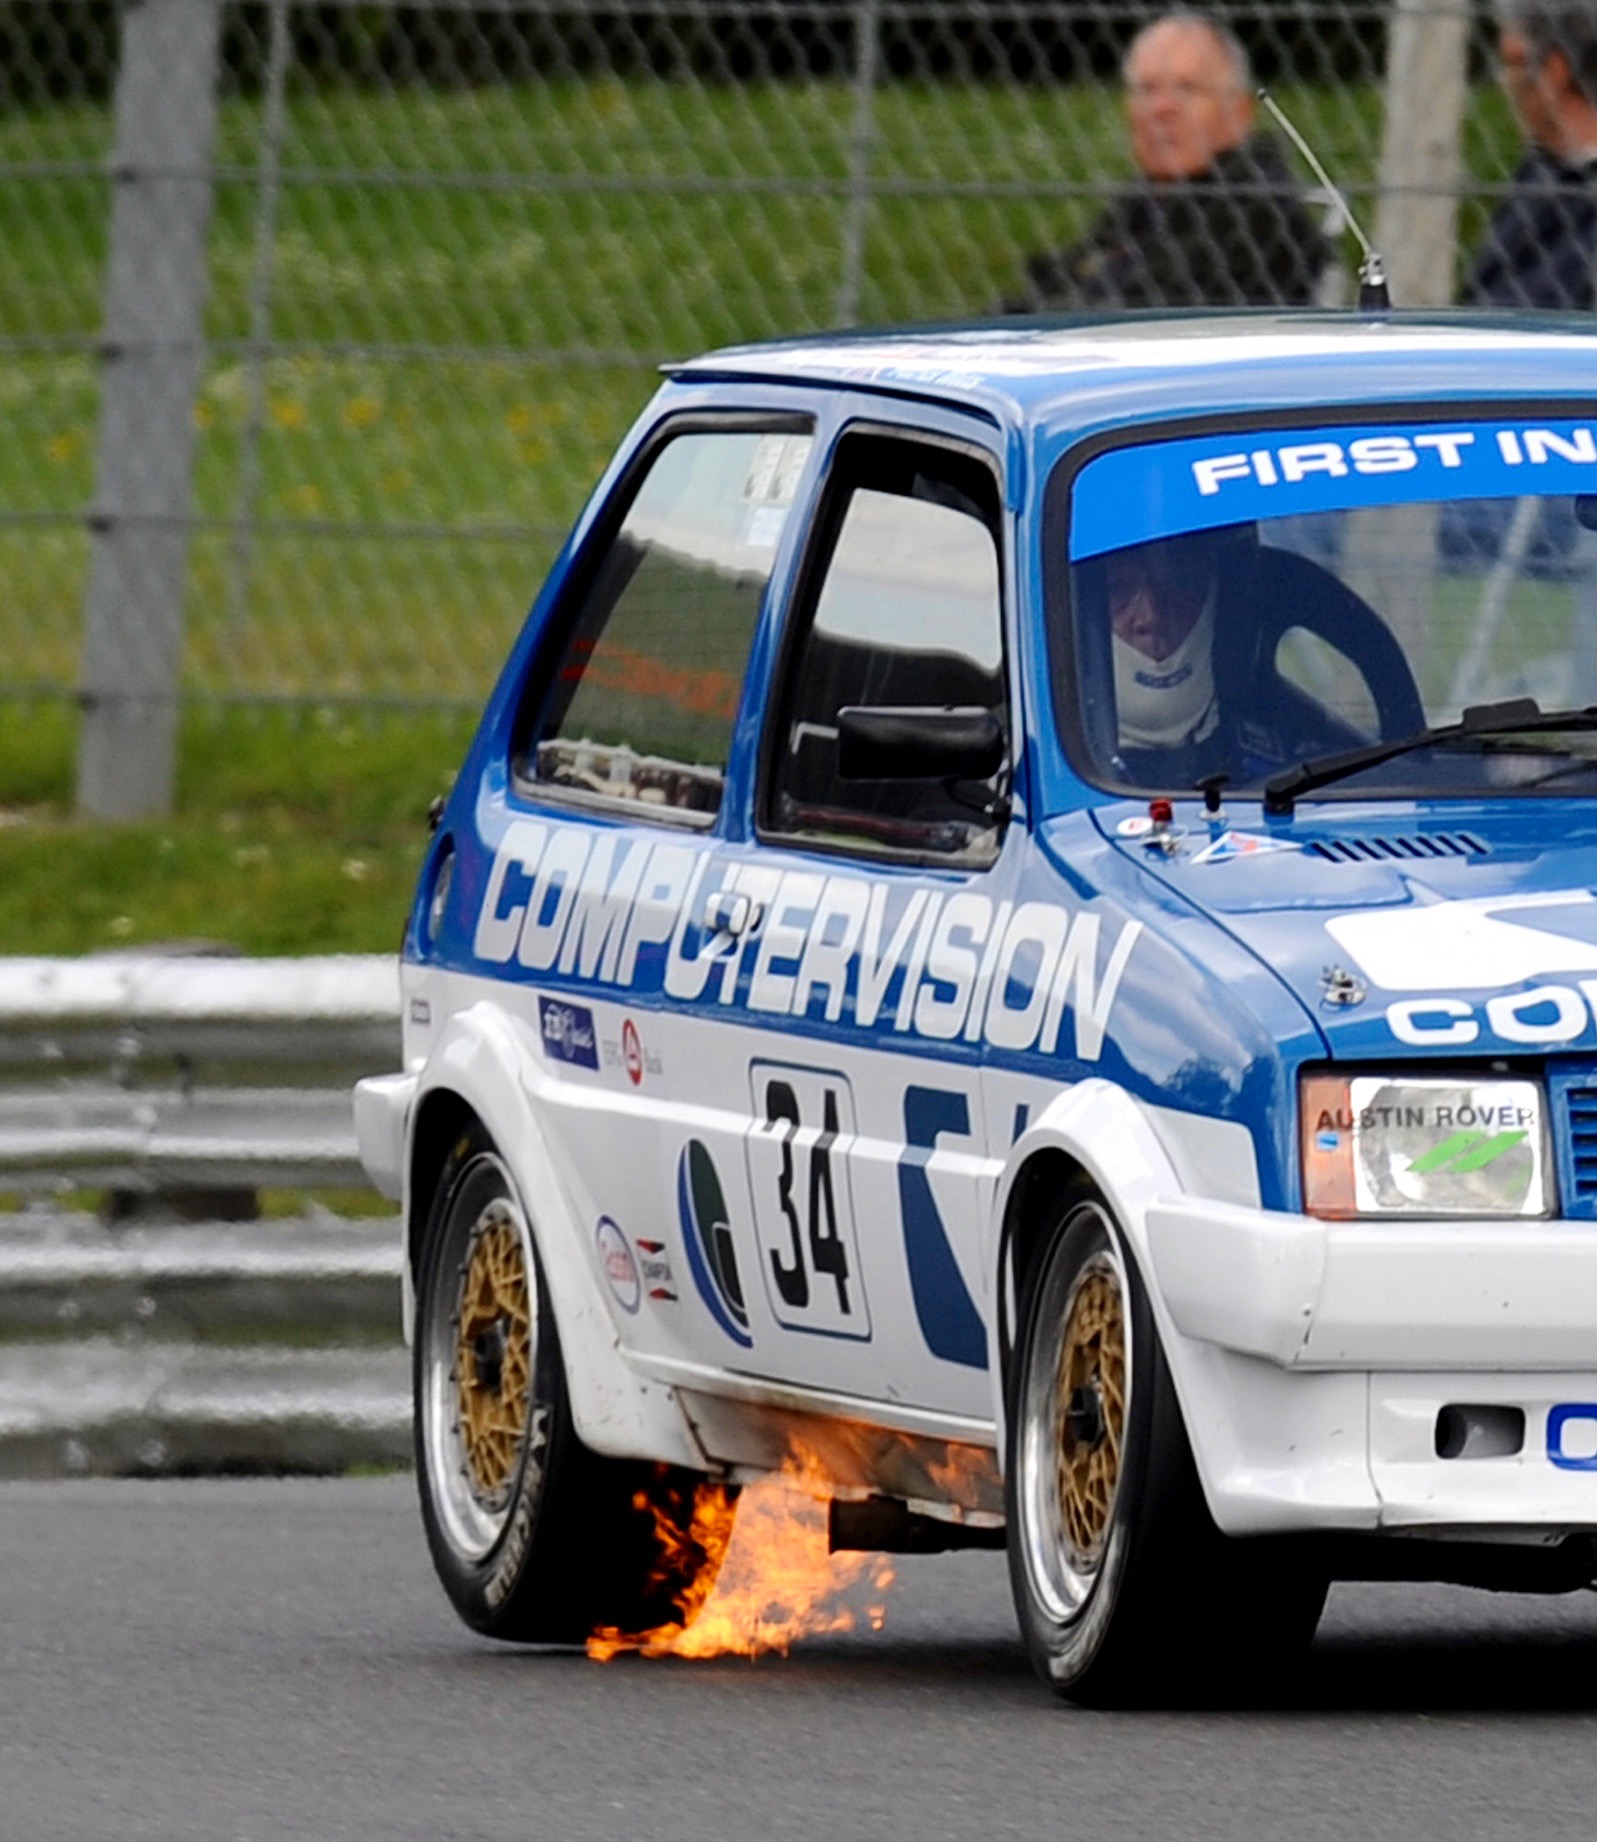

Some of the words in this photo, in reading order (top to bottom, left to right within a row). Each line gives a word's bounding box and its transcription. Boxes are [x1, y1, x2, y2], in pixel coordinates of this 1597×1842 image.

[1192, 433, 1475, 495] FIRST
[473, 820, 1144, 1062] COMPUTERVISION
[1315, 1107, 1425, 1132] AUSTIN
[1436, 1105, 1536, 1130] ROVER
[763, 1080, 851, 1315] 34
